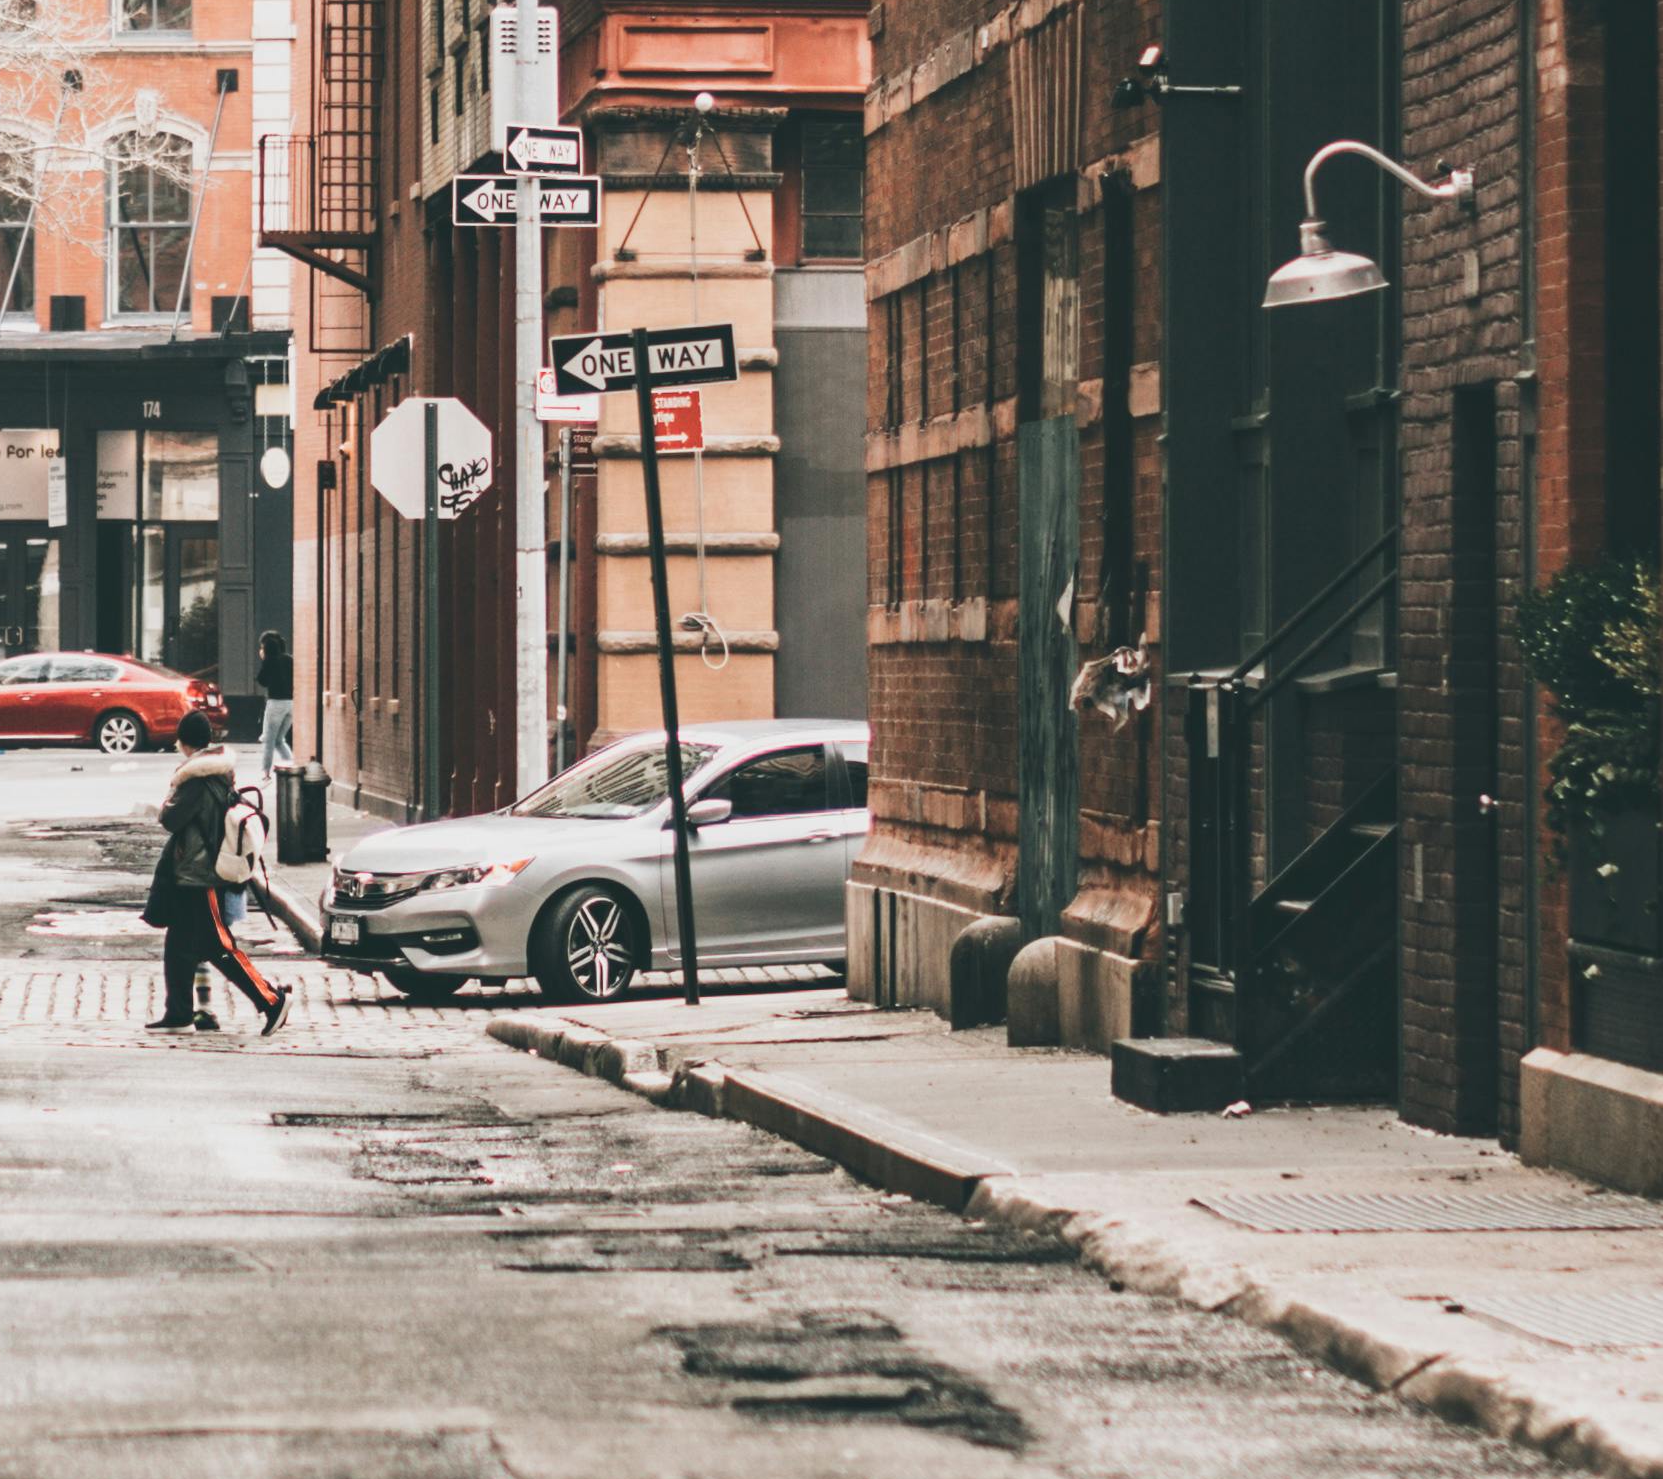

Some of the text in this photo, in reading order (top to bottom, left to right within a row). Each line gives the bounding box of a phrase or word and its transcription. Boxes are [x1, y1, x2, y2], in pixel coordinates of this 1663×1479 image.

[517, 141, 572, 159] ONE WAY
[477, 192, 580, 210] ONE WAY
[581, 344, 711, 376] ONE WAY
[143, 401, 161, 418] 174
[6, 445, 34, 459] for
